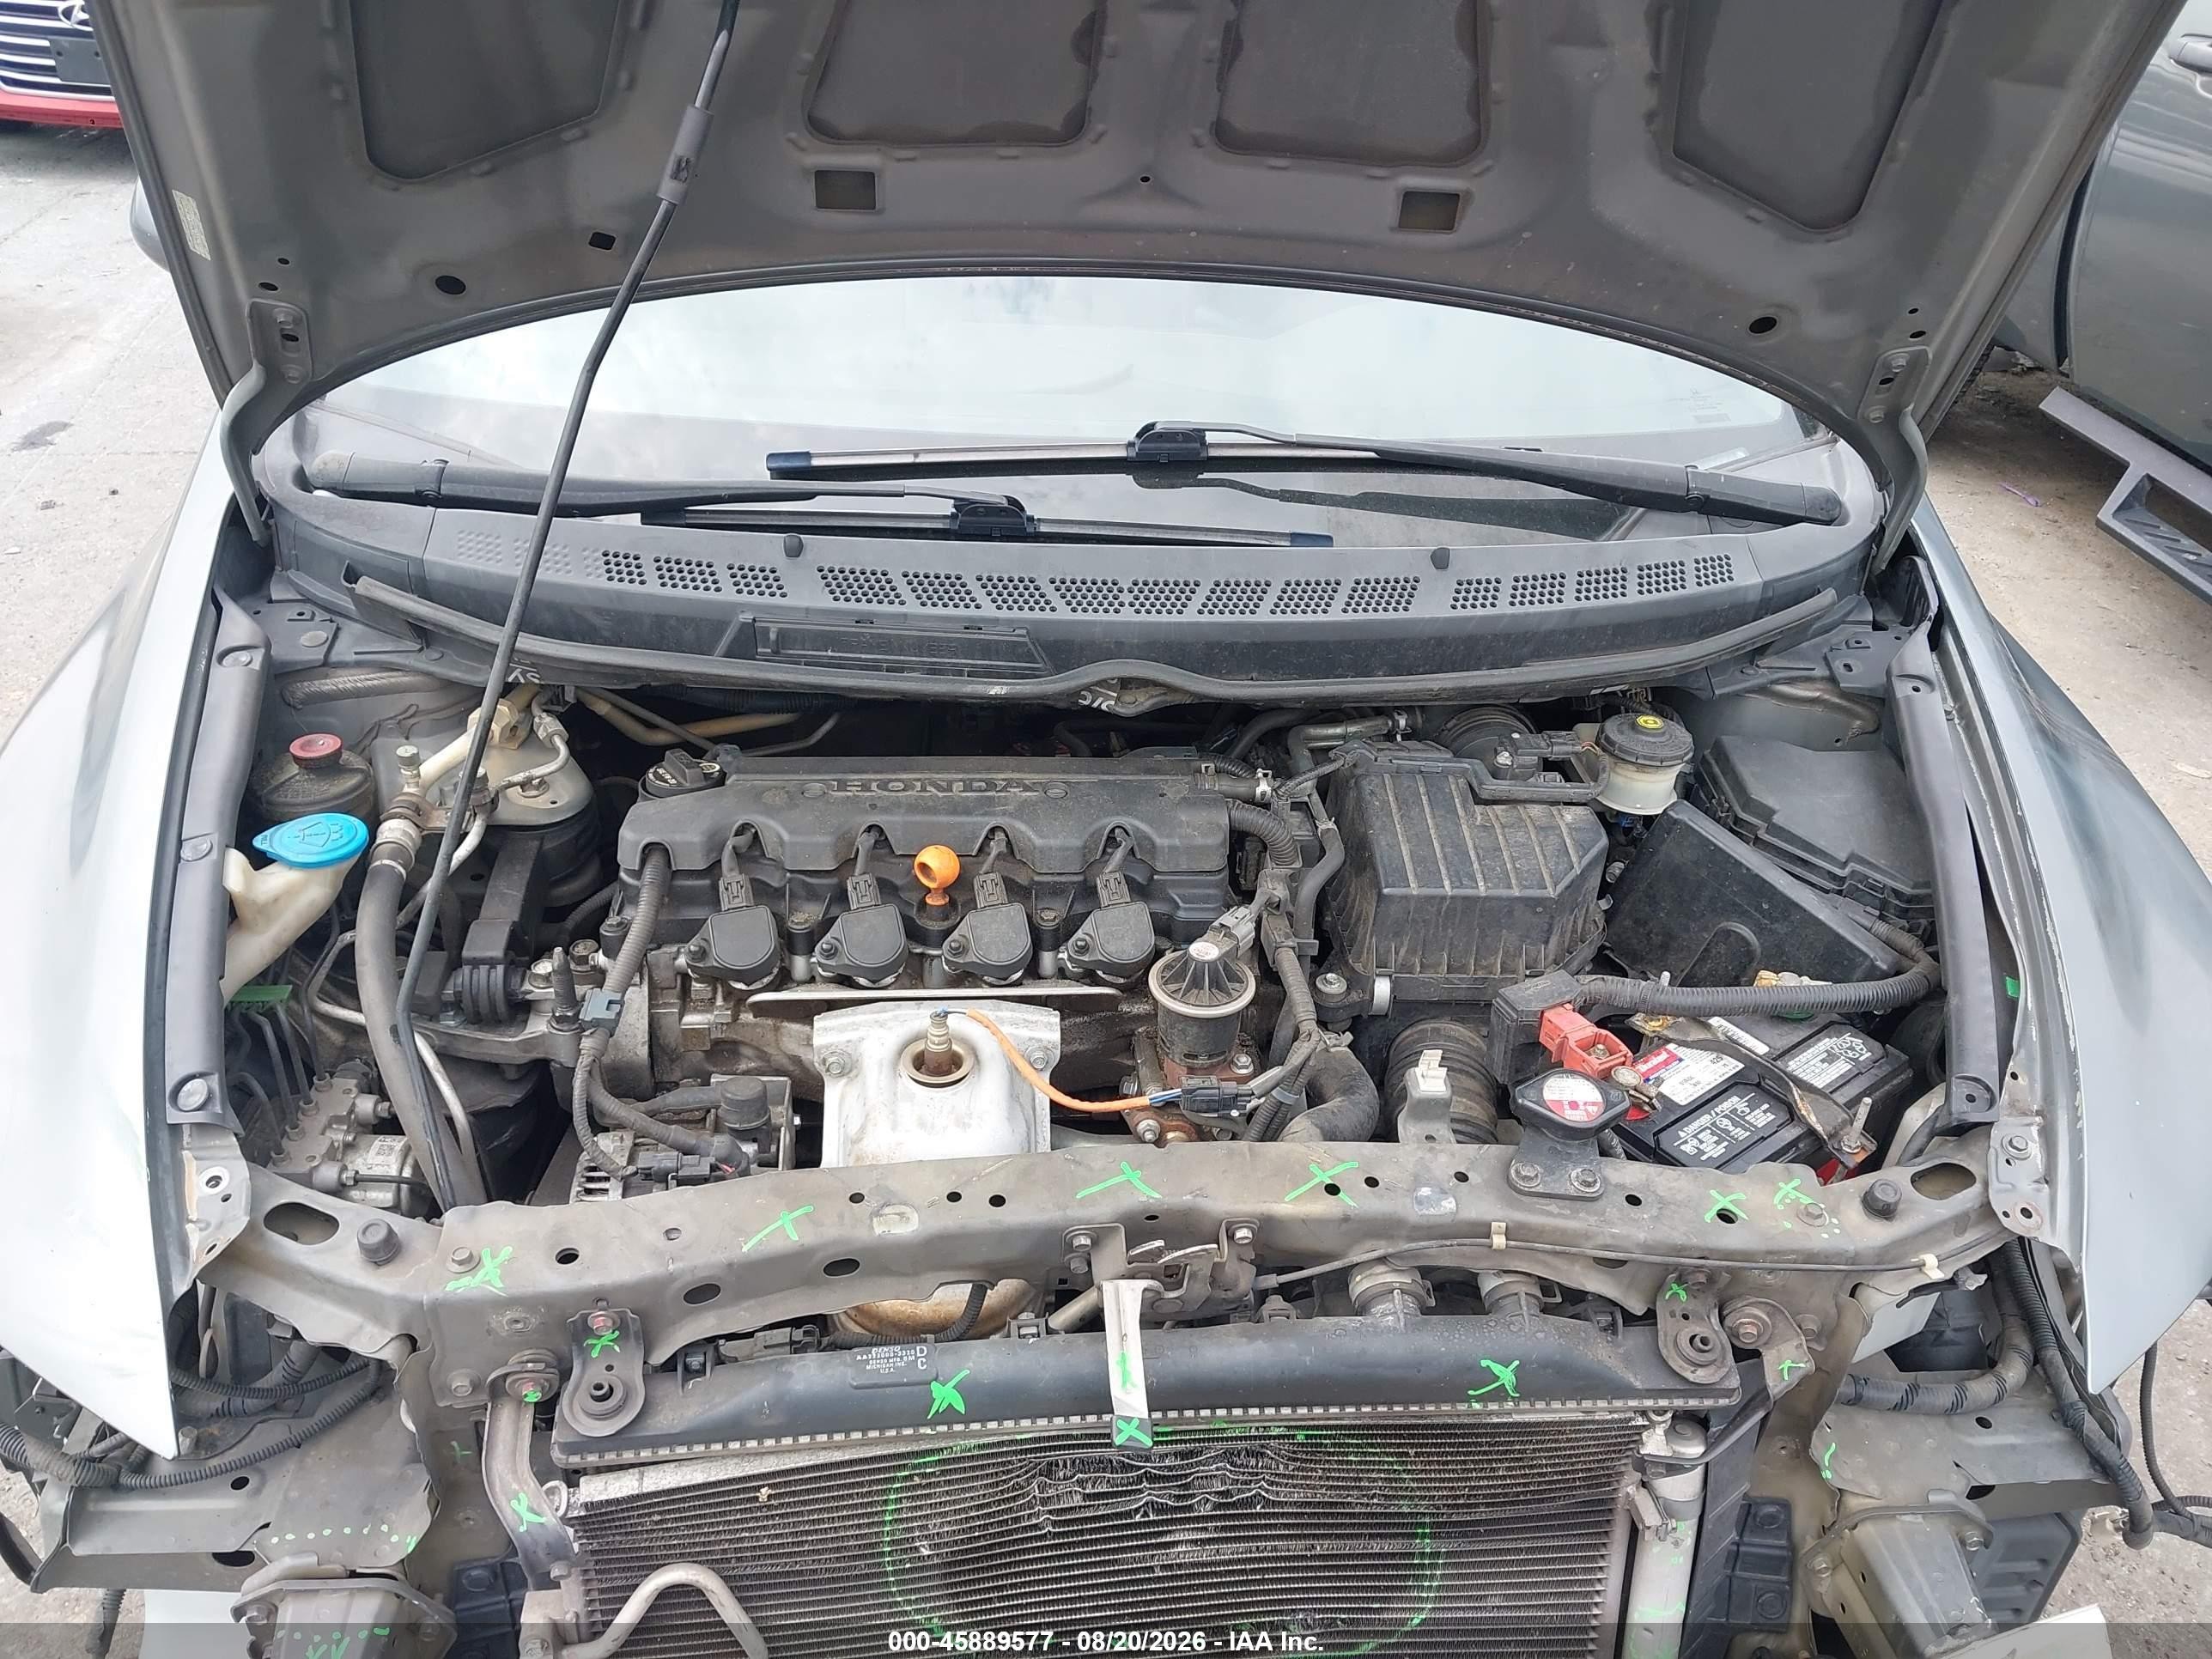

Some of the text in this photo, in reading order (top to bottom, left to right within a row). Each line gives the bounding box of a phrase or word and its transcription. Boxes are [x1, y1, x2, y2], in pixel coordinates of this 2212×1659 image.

[830, 779, 1040, 796] HONDA
[1684, 1114, 1713, 1134] DANGER
[1716, 1095, 1741, 1115] POISON
[872, 1346, 901, 1354] DENSO
